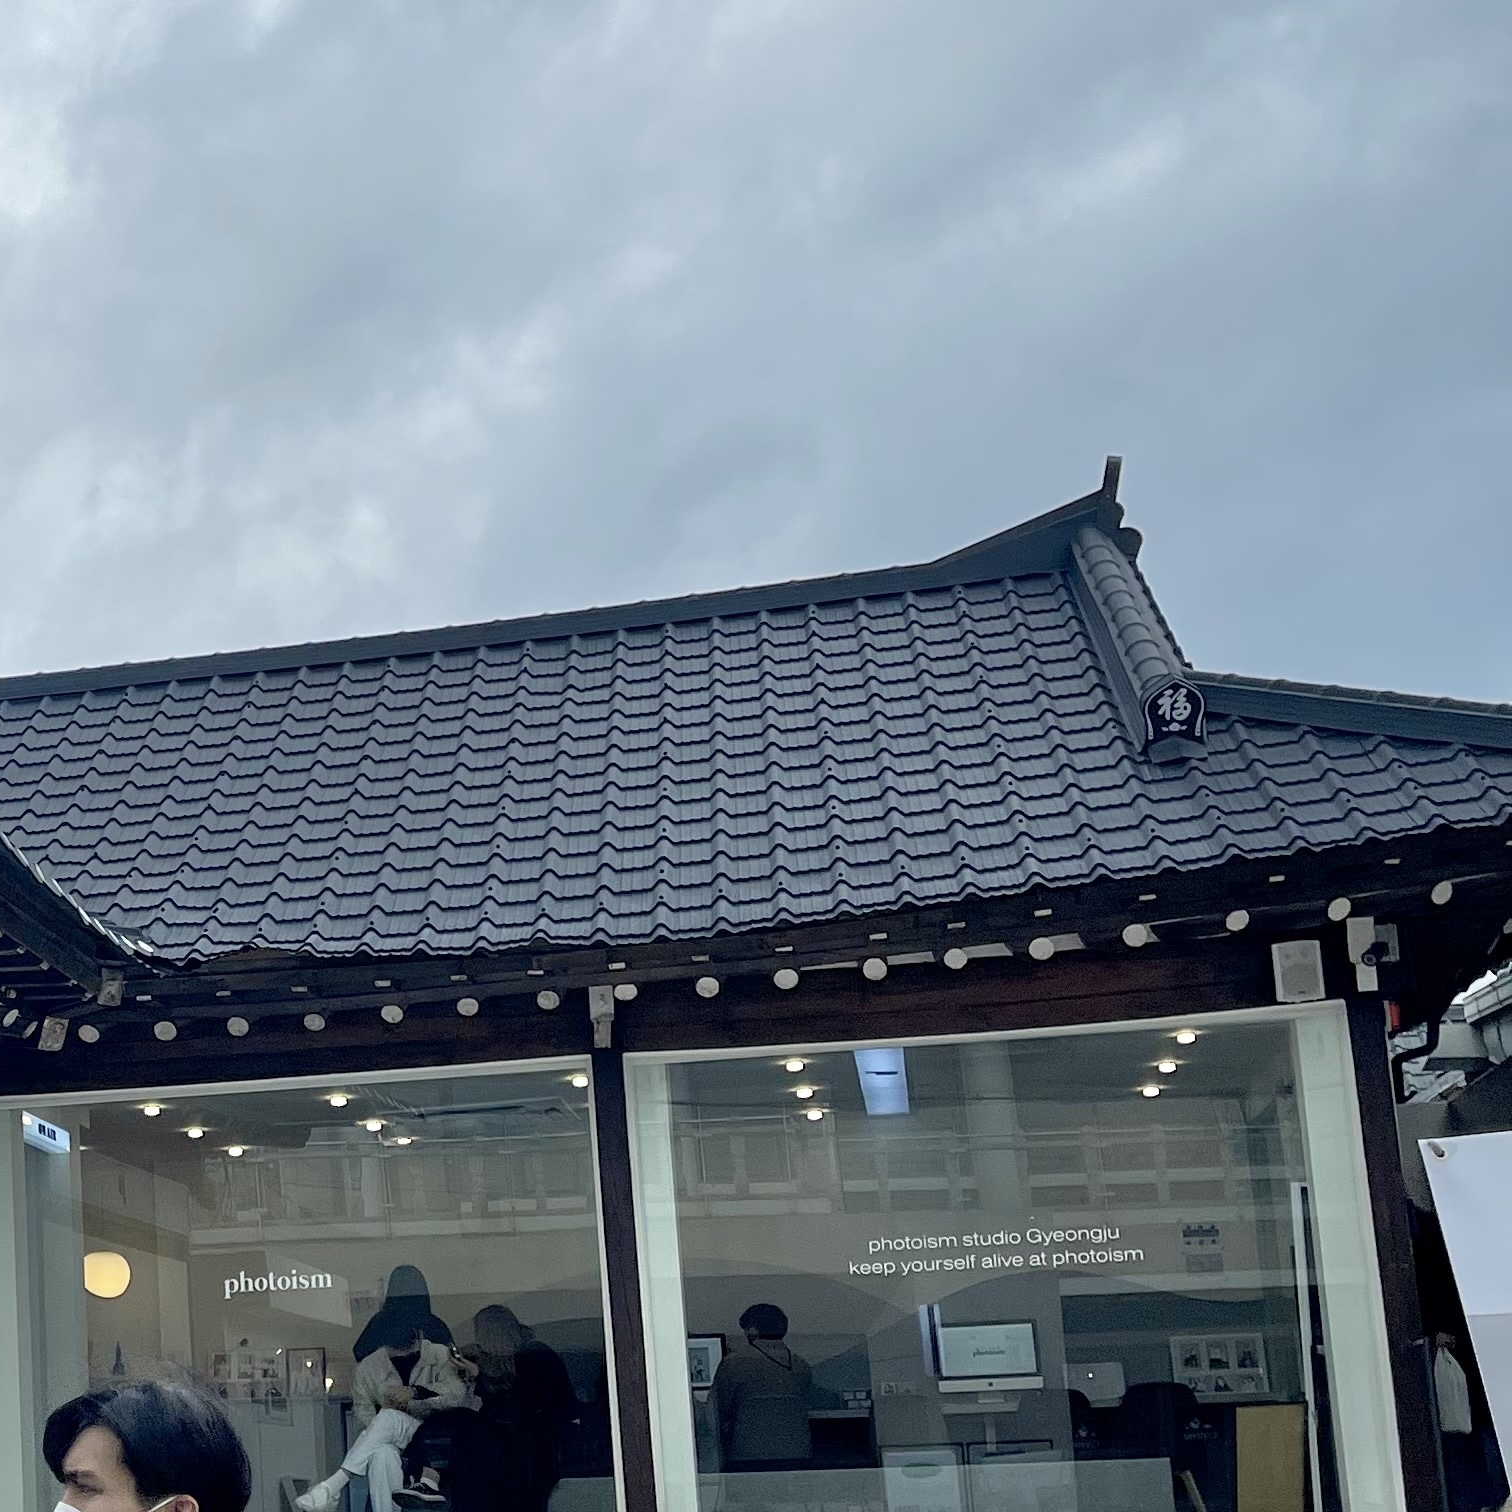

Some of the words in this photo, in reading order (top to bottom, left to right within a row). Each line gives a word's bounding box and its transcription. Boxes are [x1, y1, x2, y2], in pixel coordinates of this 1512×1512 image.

[868, 1235, 958, 1254] photoism
[962, 1229, 1021, 1247] studio
[1026, 1225, 1120, 1246] Gyeongju
[849, 1260, 896, 1276] keep
[900, 1254, 976, 1276] yourself
[981, 1253, 1024, 1269] alive
[1029, 1251, 1047, 1267] at
[1052, 1248, 1144, 1268] photoism
[224, 1269, 333, 1300] photoism
